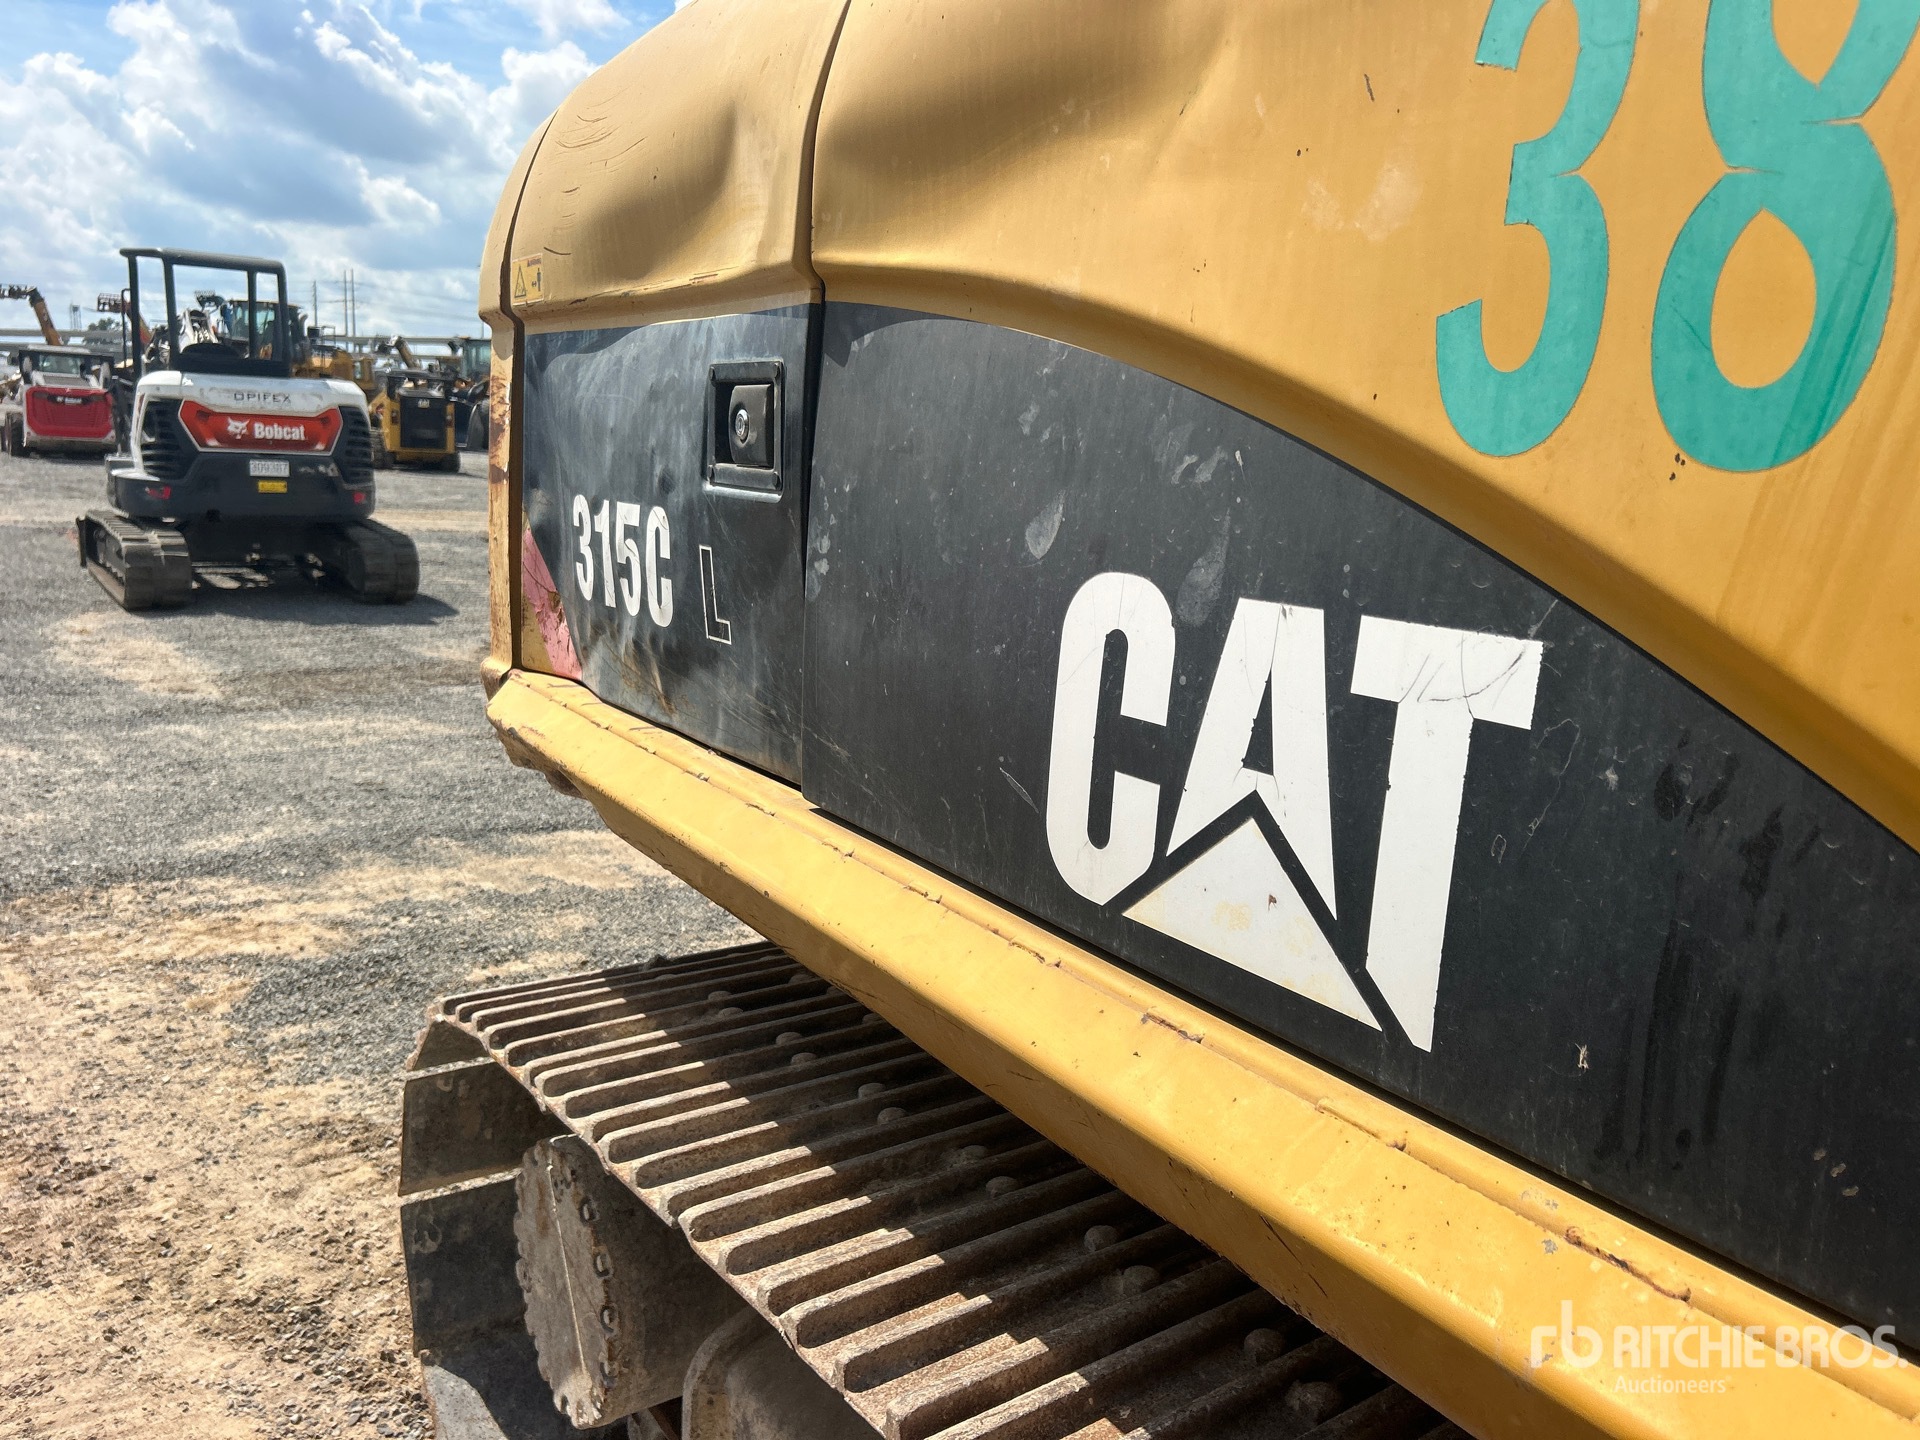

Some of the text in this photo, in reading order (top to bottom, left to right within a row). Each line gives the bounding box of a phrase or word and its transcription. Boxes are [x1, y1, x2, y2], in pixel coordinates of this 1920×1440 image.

[1436, 0, 1920, 472] 38
[233, 391, 291, 404] OPIFEX
[254, 422, 306, 440] Bobcat
[573, 494, 732, 646] 315C L
[1046, 571, 1544, 1053] CAT
